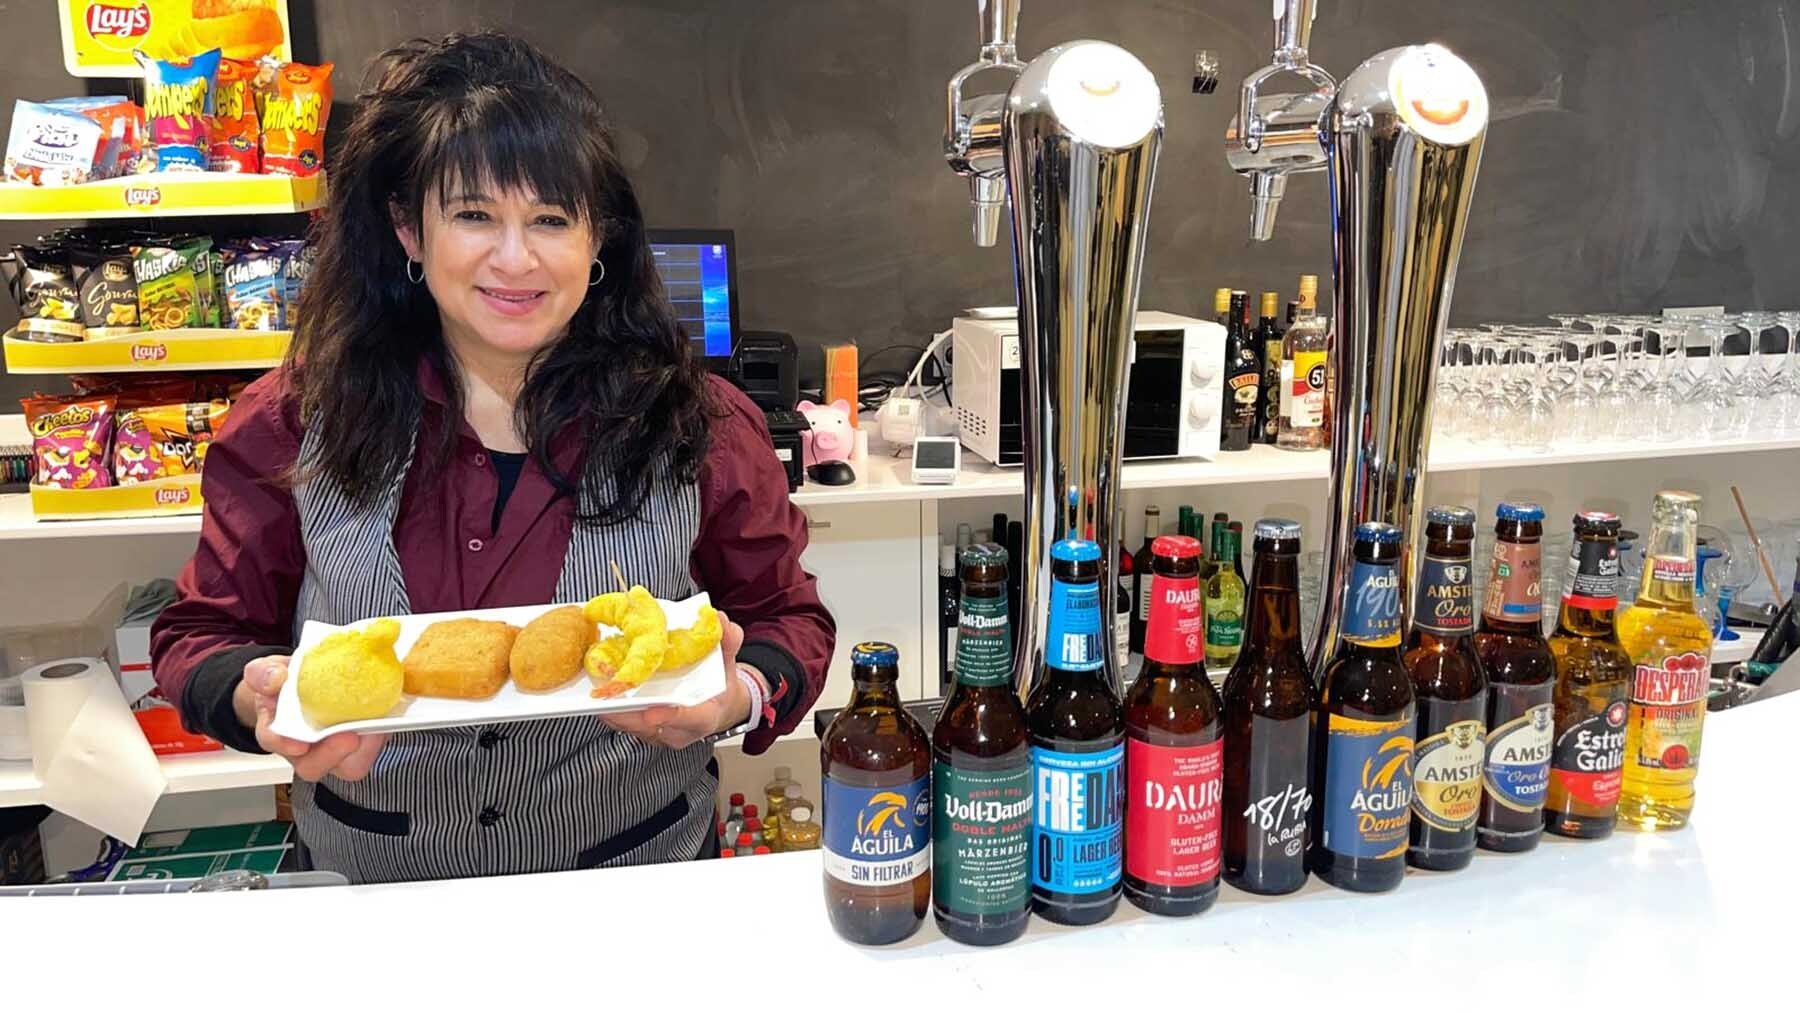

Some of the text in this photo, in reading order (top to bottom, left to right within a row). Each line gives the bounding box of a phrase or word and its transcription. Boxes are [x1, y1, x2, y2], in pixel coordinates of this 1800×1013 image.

[91, 4, 149, 37] Lay's
[33, 405, 94, 437] Cheetos
[1145, 775, 1223, 812] DAUR
[1392, 780, 1402, 791] EL
[1439, 784, 1478, 803] Oro
[1178, 808, 1216, 825] DAMM
[1243, 783, 1313, 832] 18/70
[883, 829, 894, 839] EL
[851, 861, 913, 881] SIN FILTRAR
